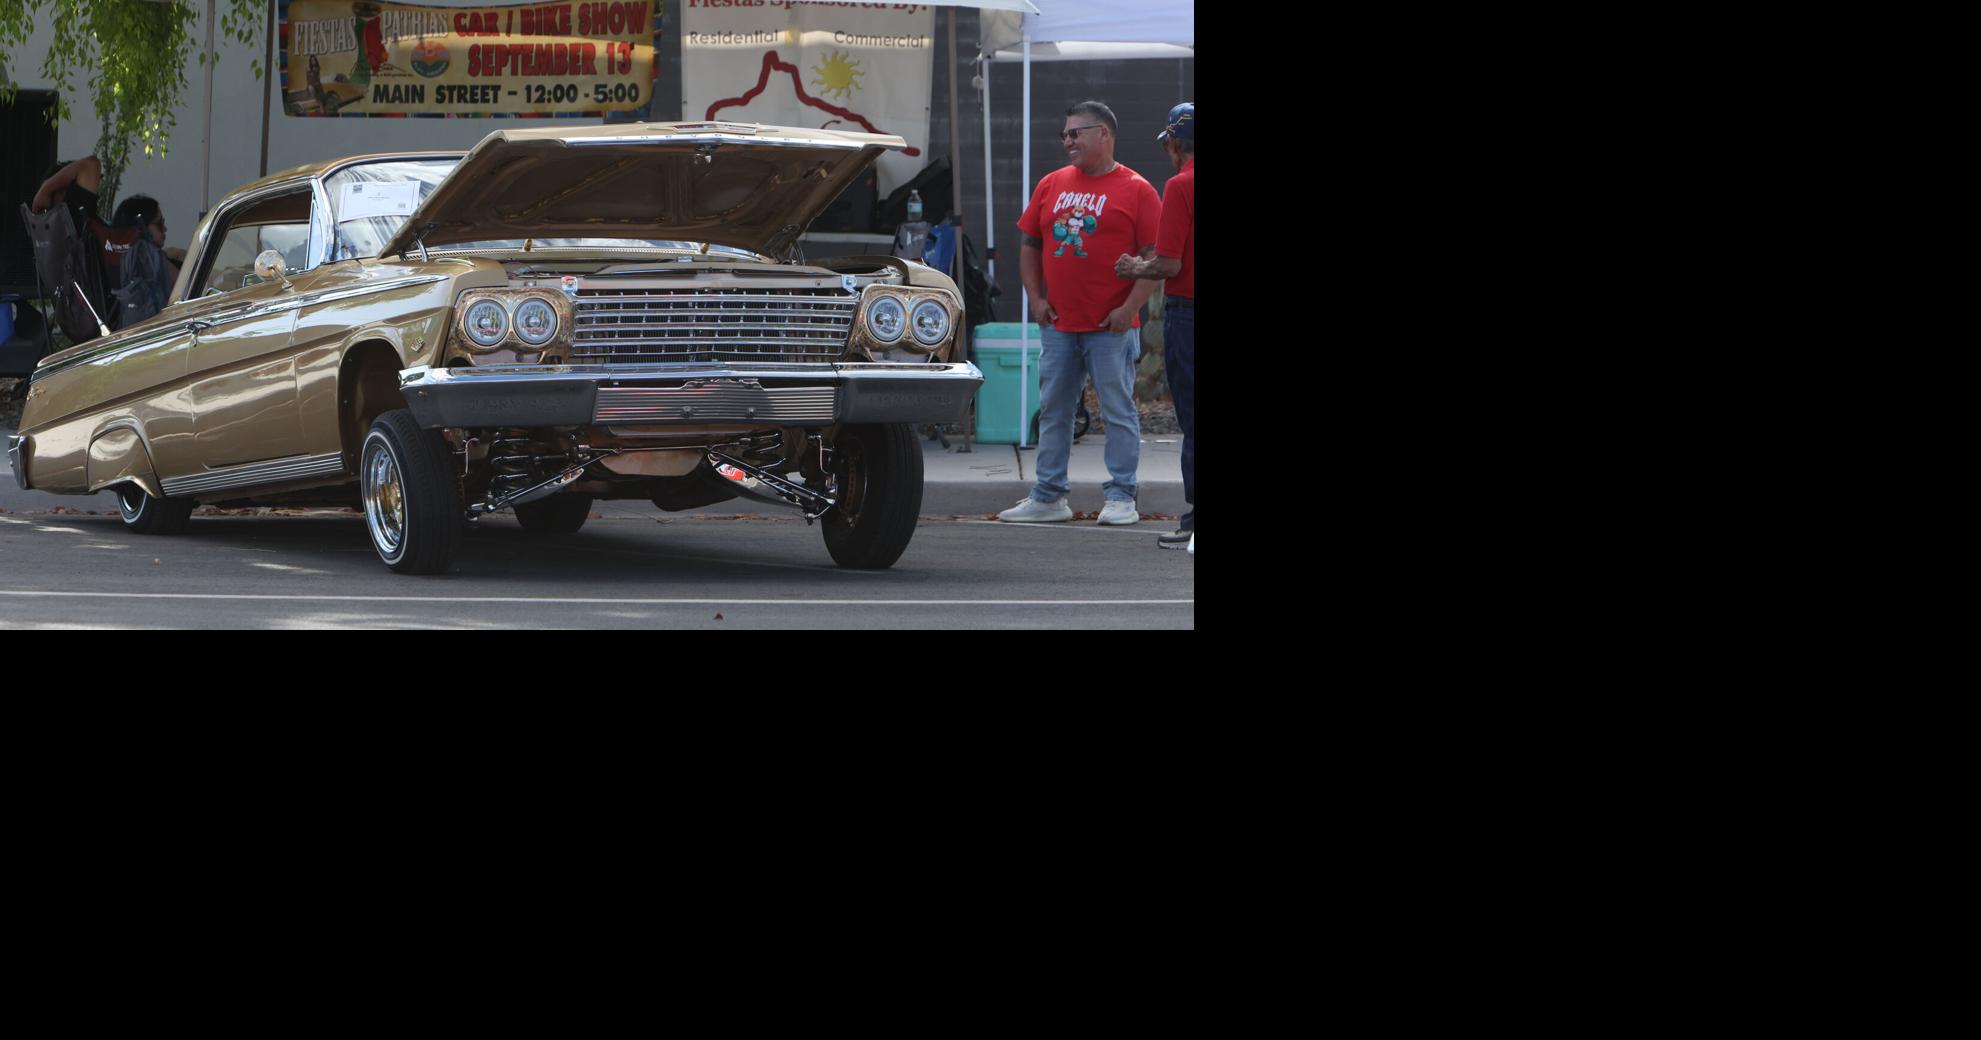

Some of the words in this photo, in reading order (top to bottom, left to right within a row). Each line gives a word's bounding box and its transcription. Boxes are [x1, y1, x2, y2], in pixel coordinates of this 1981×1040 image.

[453, 12, 500, 37] CAR
[505, 10, 514, 37] /
[520, 4, 573, 36] BIKE
[578, 1, 648, 36] SHOW
[294, 18, 357, 56] FIESTAS
[381, 9, 449, 44] PATRIAS
[690, 29, 778, 45] Residential
[834, 30, 924, 48] Commercial
[467, 43, 598, 77] SEPTEMBER
[372, 84, 425, 104] MAIN
[435, 84, 501, 104] STREET
[524, 82, 578, 104] 12:00
[593, 83, 640, 103] 5:00
[1052, 191, 1107, 216] CANELO
